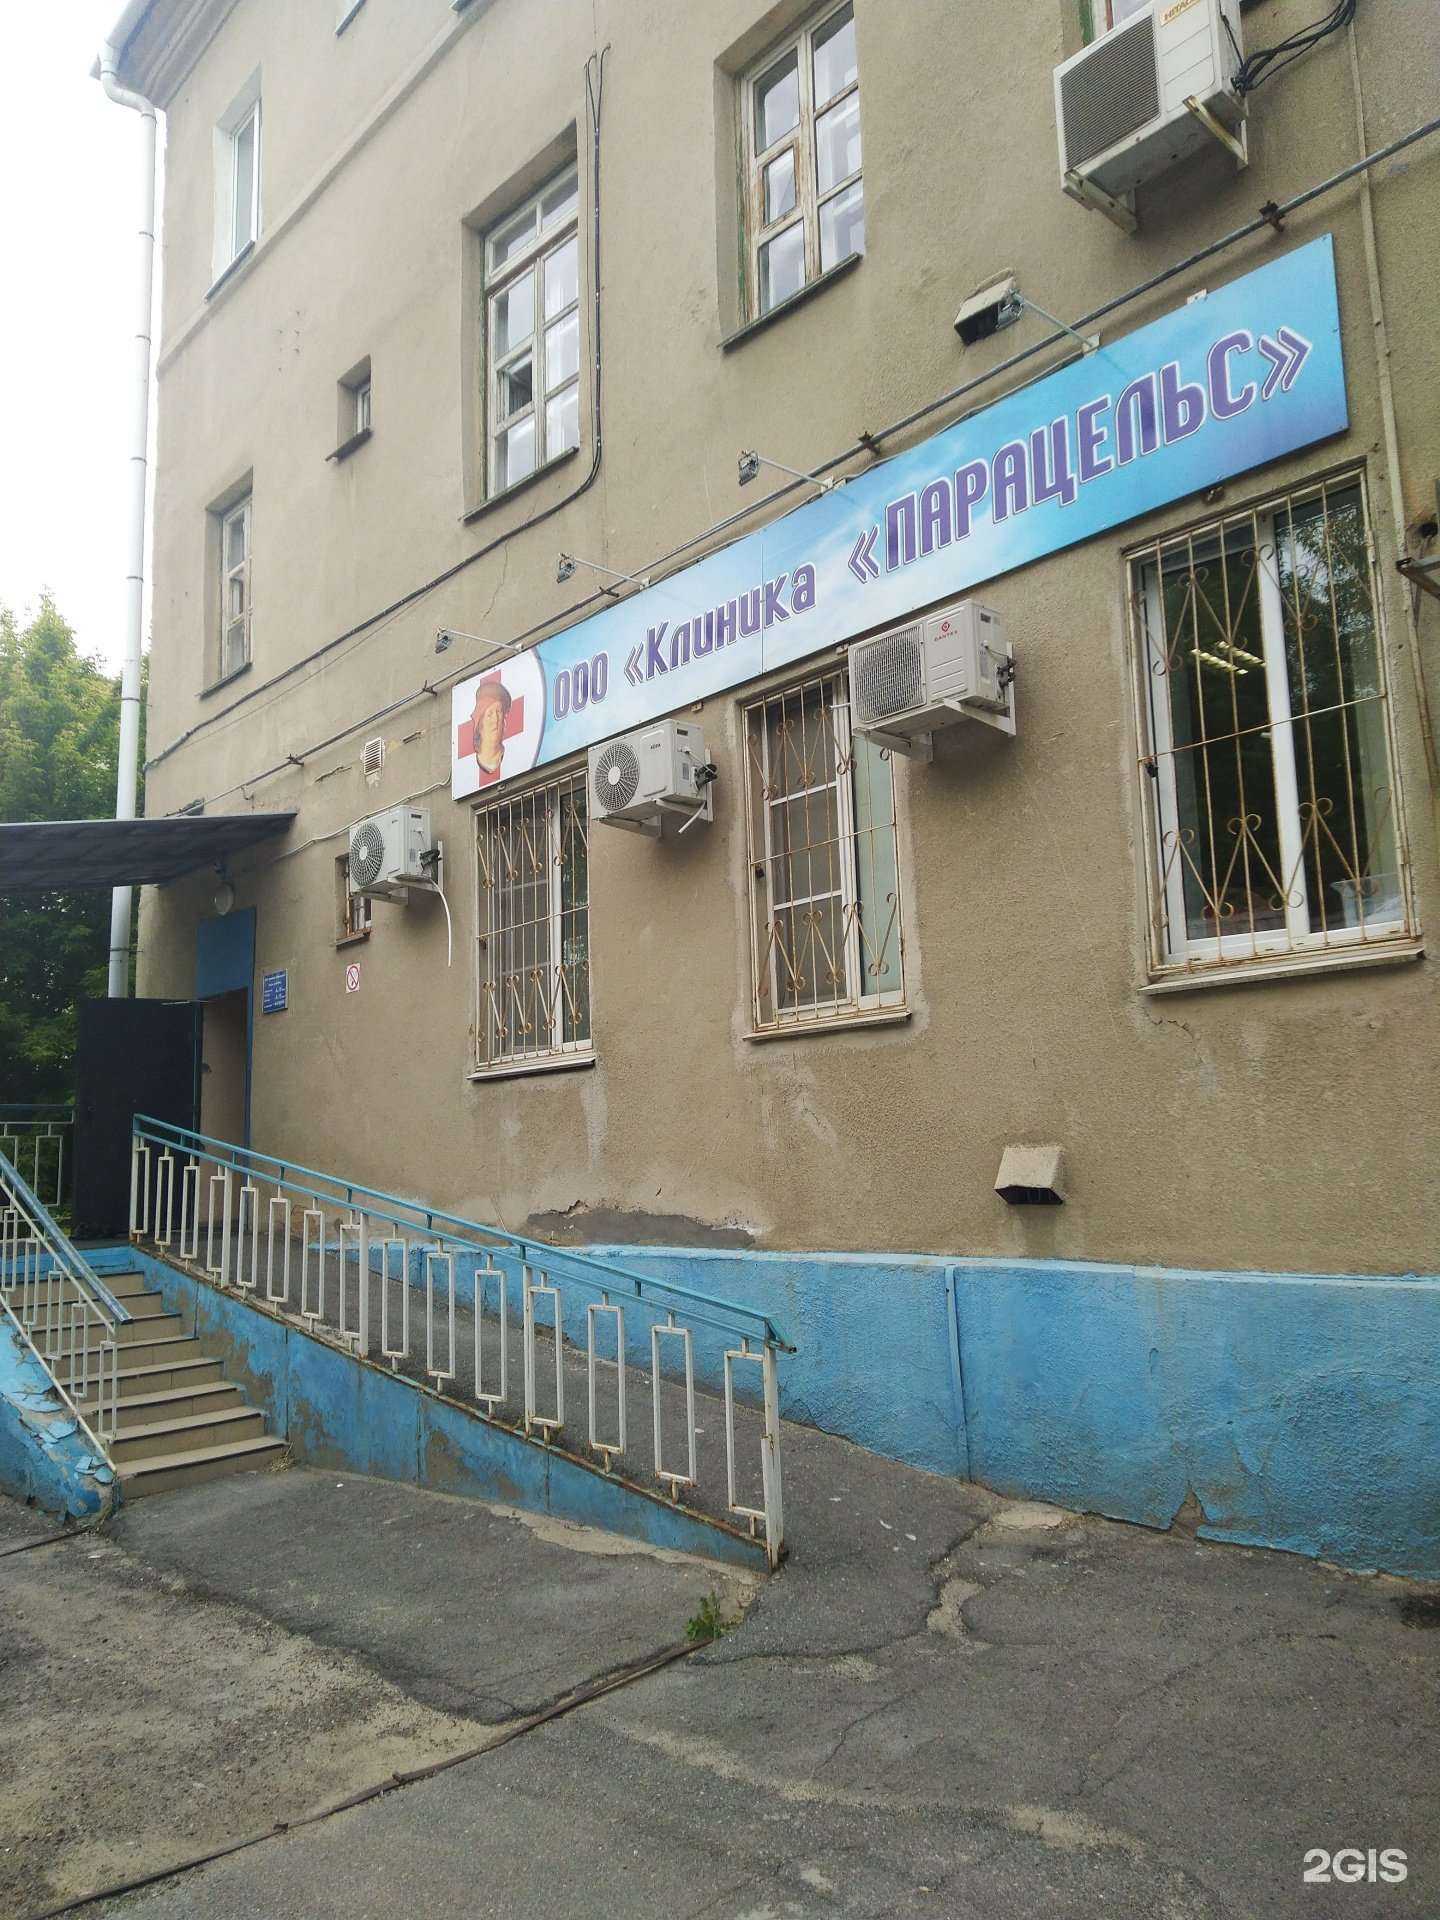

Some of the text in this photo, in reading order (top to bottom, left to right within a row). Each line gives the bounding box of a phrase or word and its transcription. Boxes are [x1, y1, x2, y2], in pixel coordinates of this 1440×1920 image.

[553, 326, 1313, 721] ООО «Клиника «ПАРАЦЕЛЬС»
